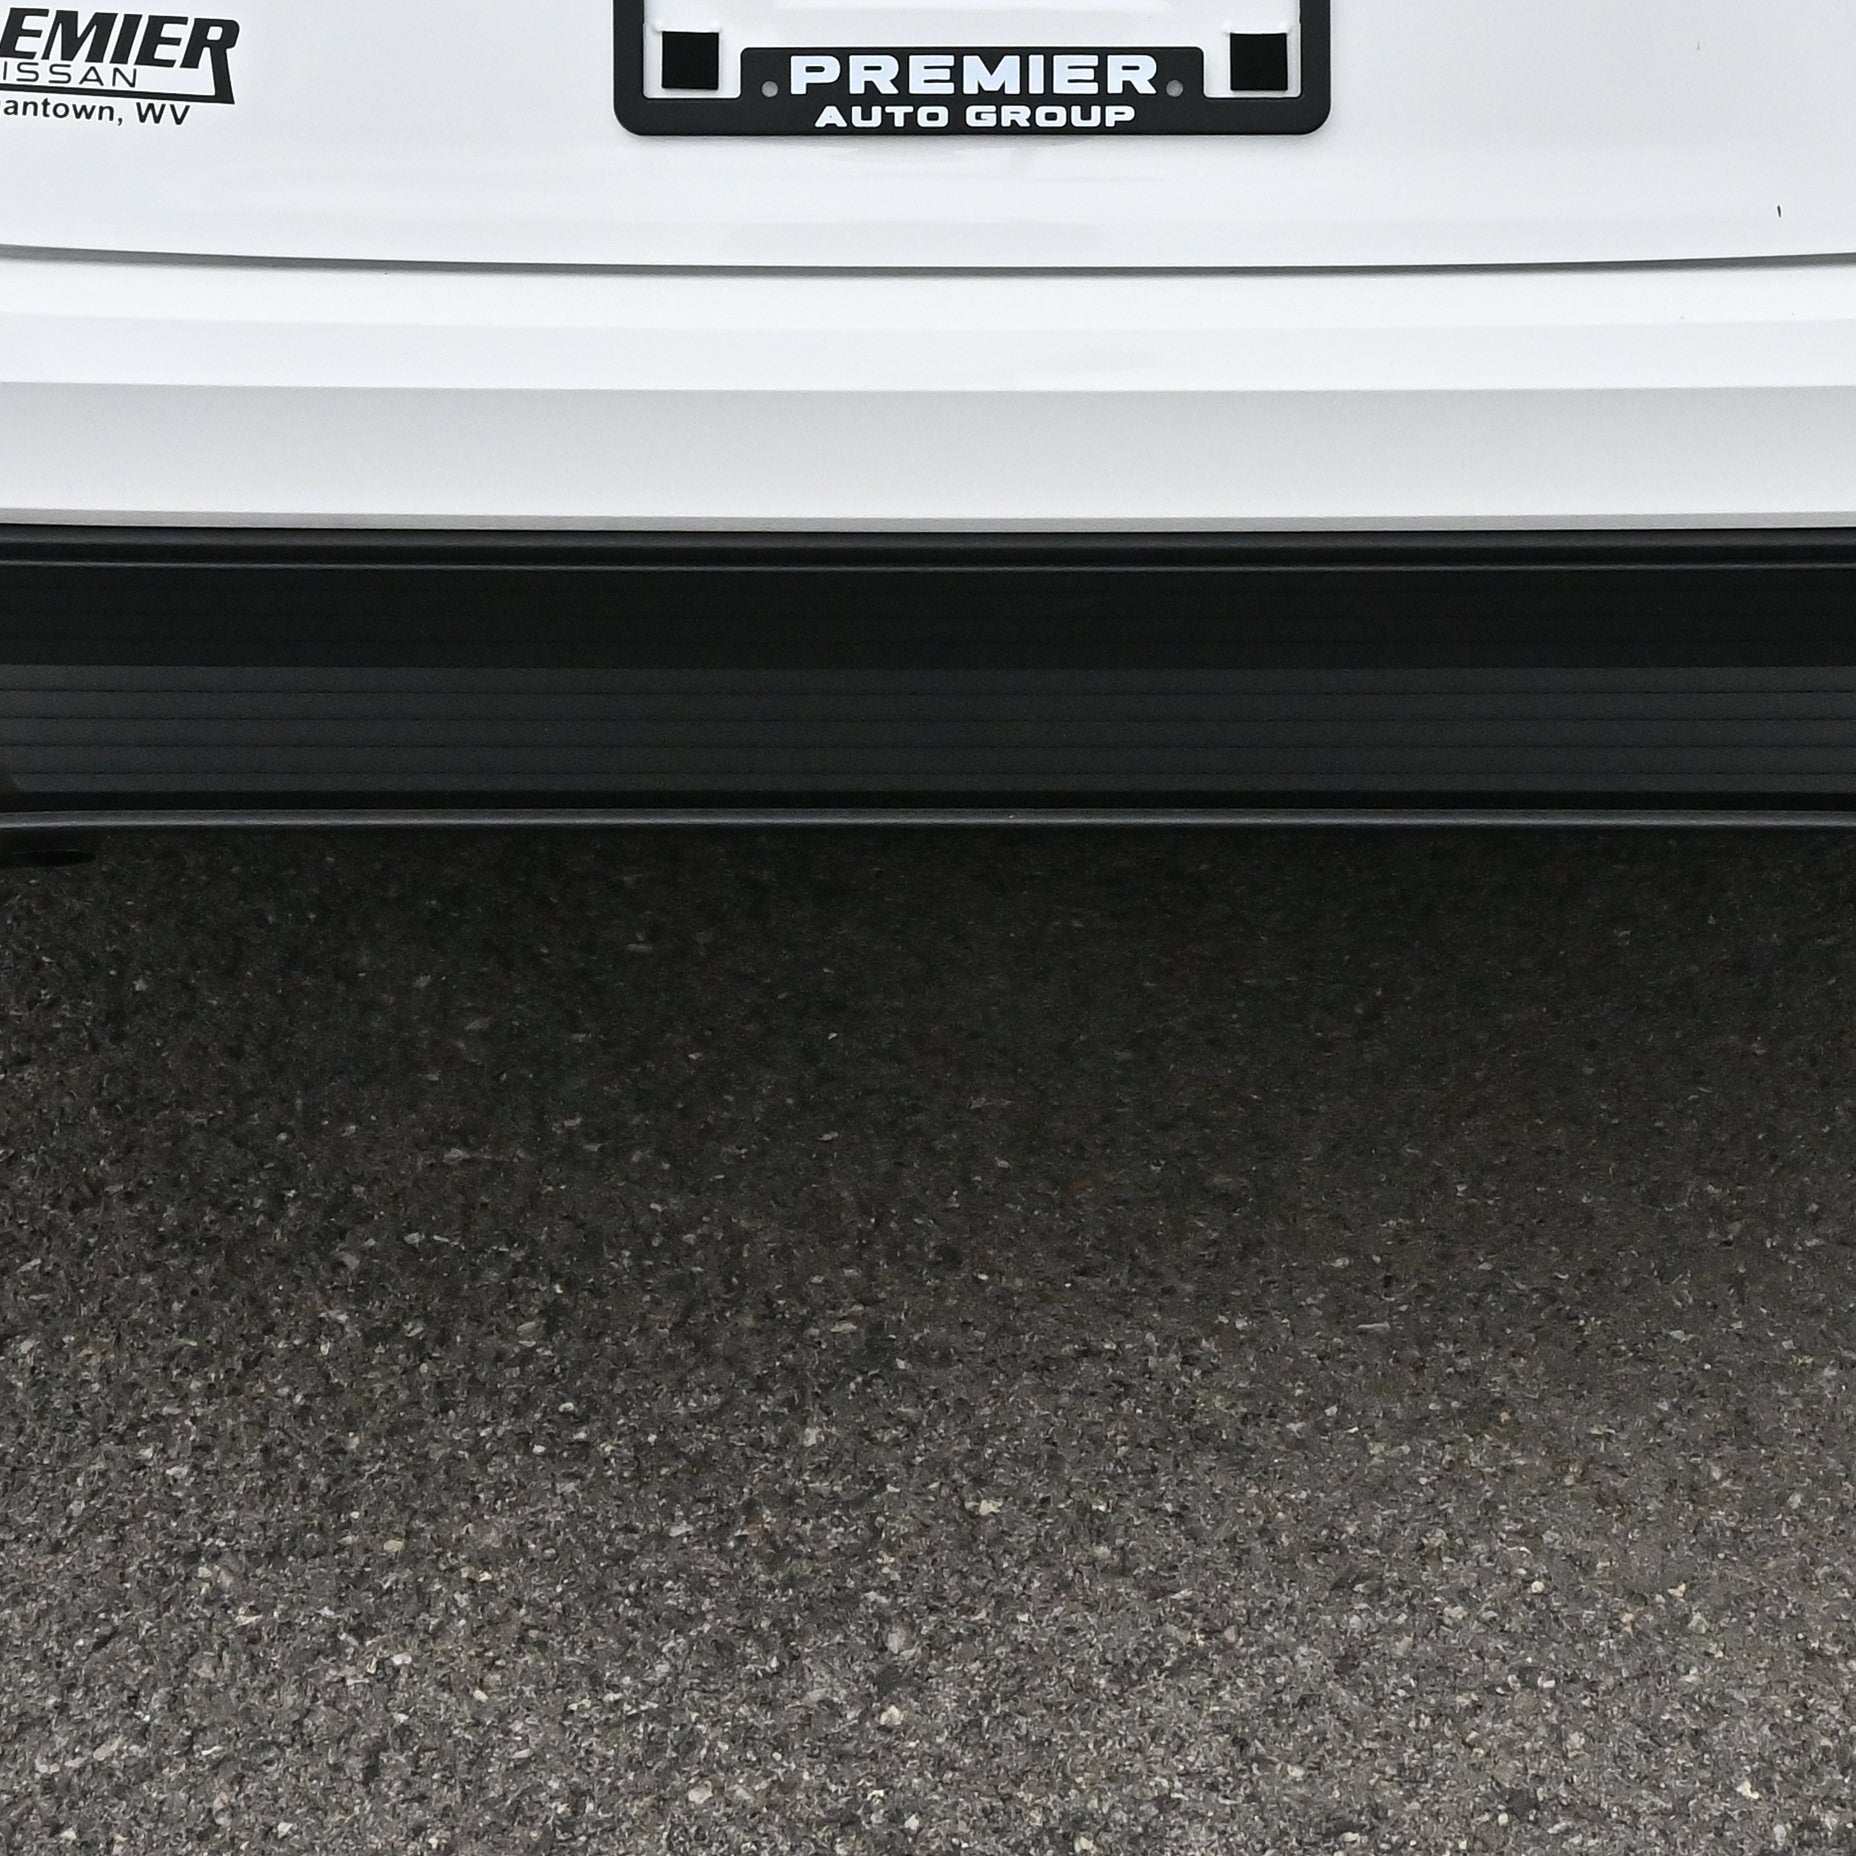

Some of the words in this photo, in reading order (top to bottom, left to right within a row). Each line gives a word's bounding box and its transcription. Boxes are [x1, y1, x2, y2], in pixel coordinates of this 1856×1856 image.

[790, 54, 1159, 95] PREMIER
[135, 101, 191, 126] WV
[814, 105, 950, 128] AUTO
[965, 105, 1136, 129] GROUP
